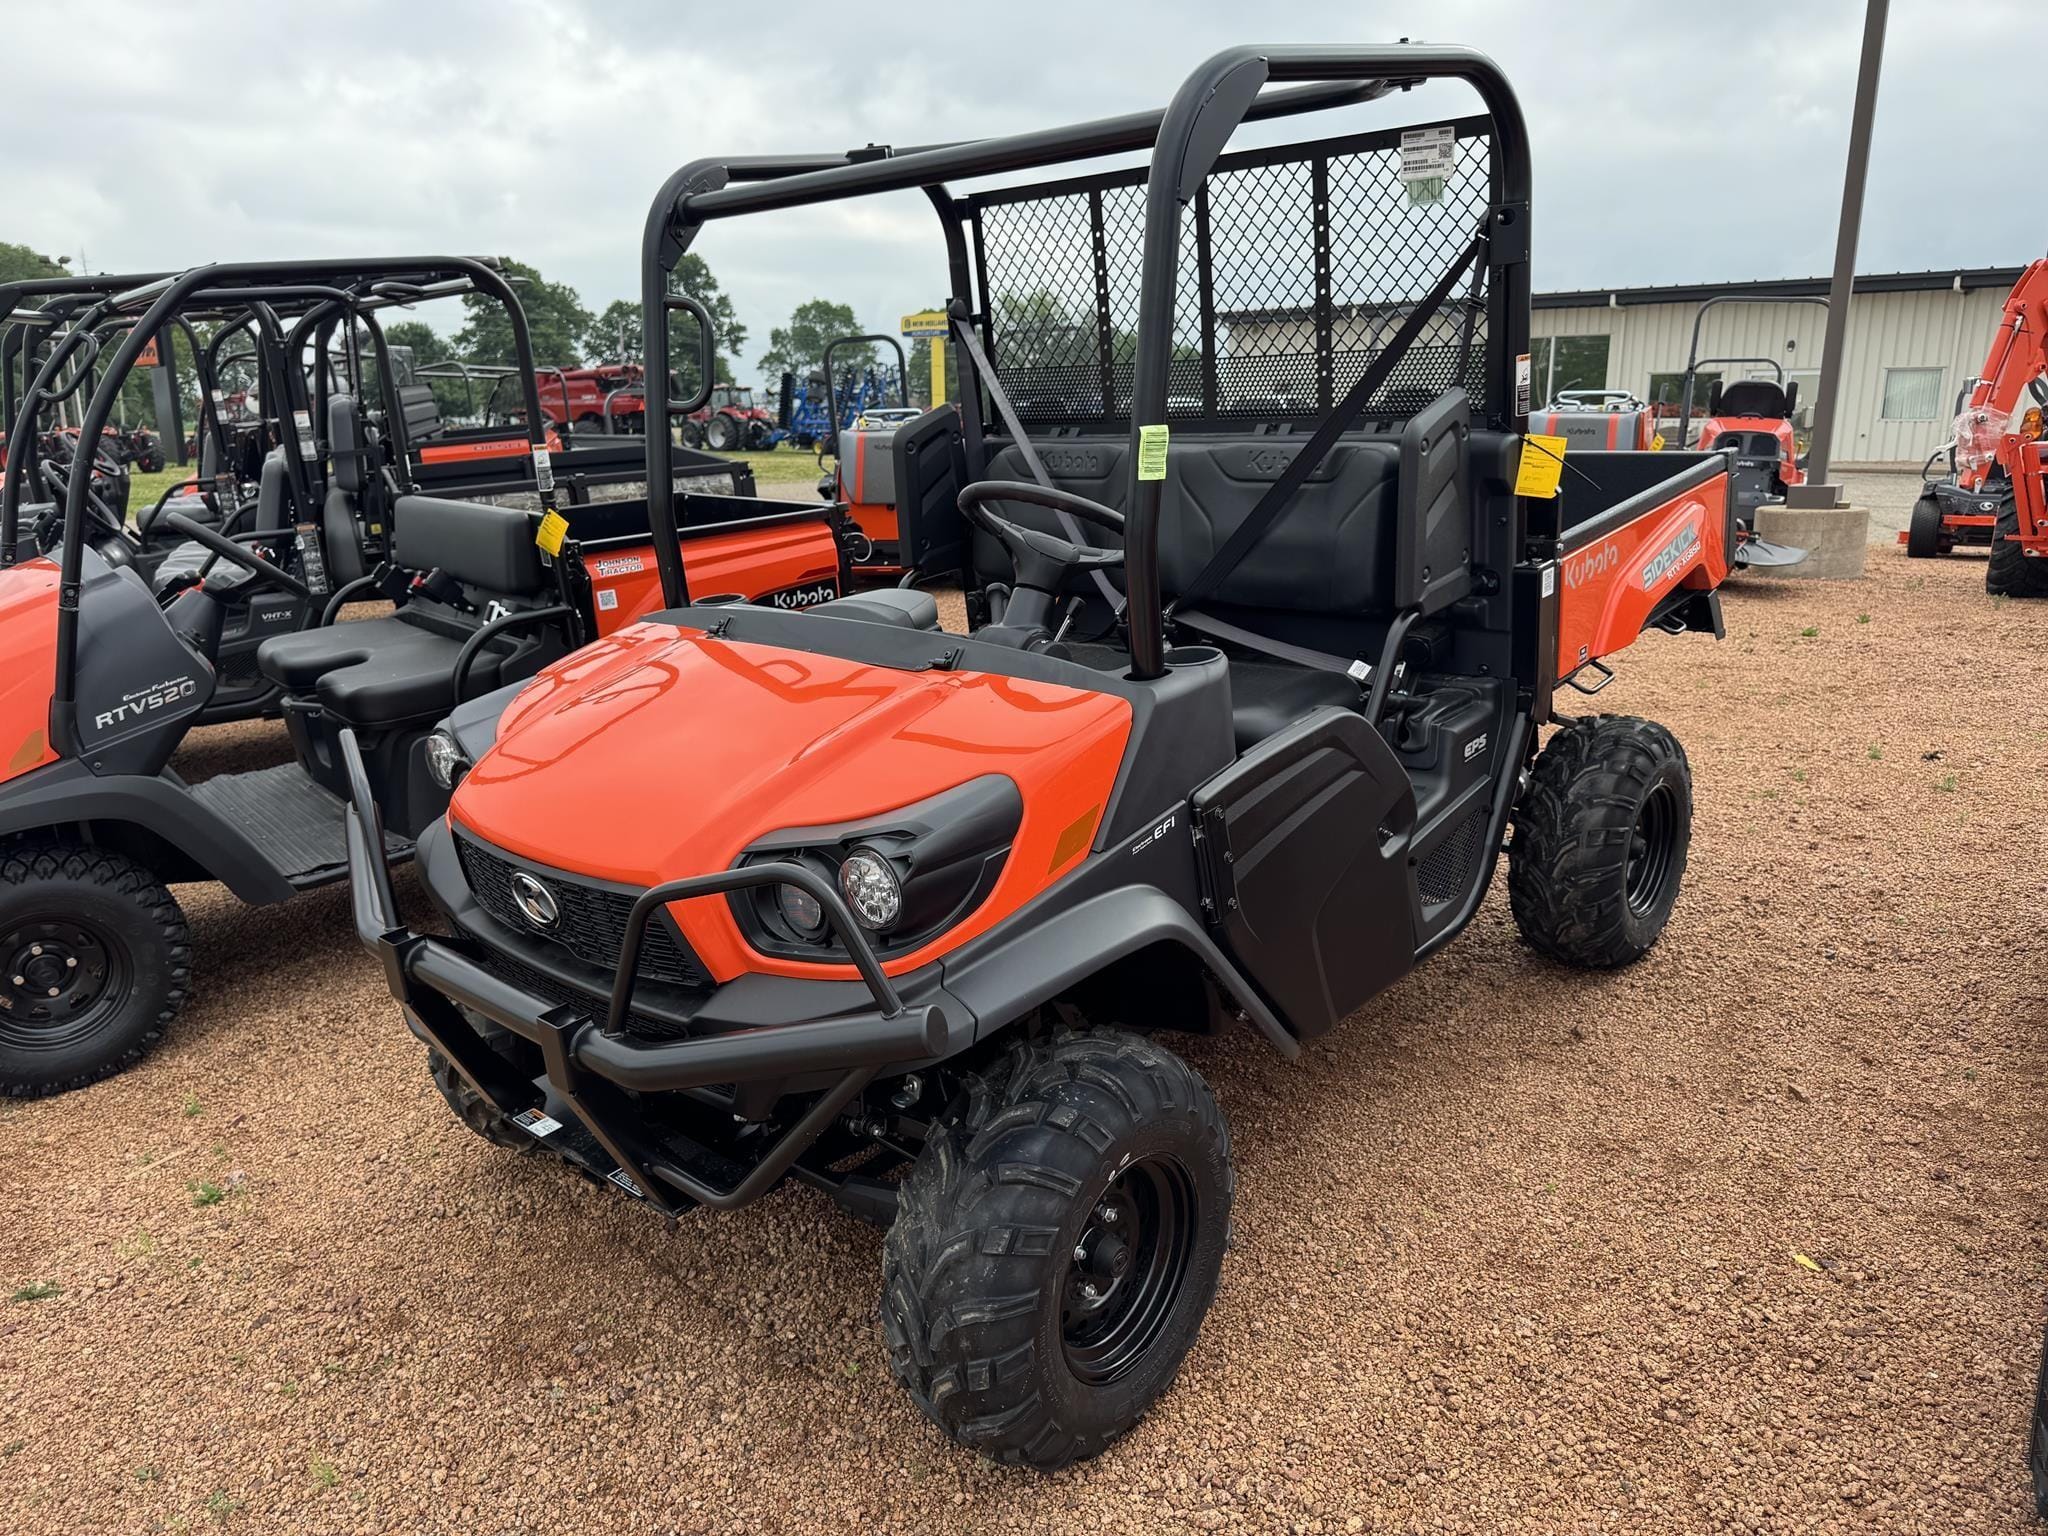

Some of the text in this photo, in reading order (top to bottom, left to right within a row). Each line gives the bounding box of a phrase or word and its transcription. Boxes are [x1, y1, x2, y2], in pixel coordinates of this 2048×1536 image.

[596, 556, 640, 568] JOHNSON
[1565, 543, 1619, 589] Kubota
[1642, 521, 1698, 590] SIDEKICK
[599, 564, 643, 576] TRACTOR
[774, 586, 835, 609] Kubota
[95, 680, 197, 730] RTV520
[1464, 733, 1487, 758] EPS
[1154, 816, 1175, 840] EFI
